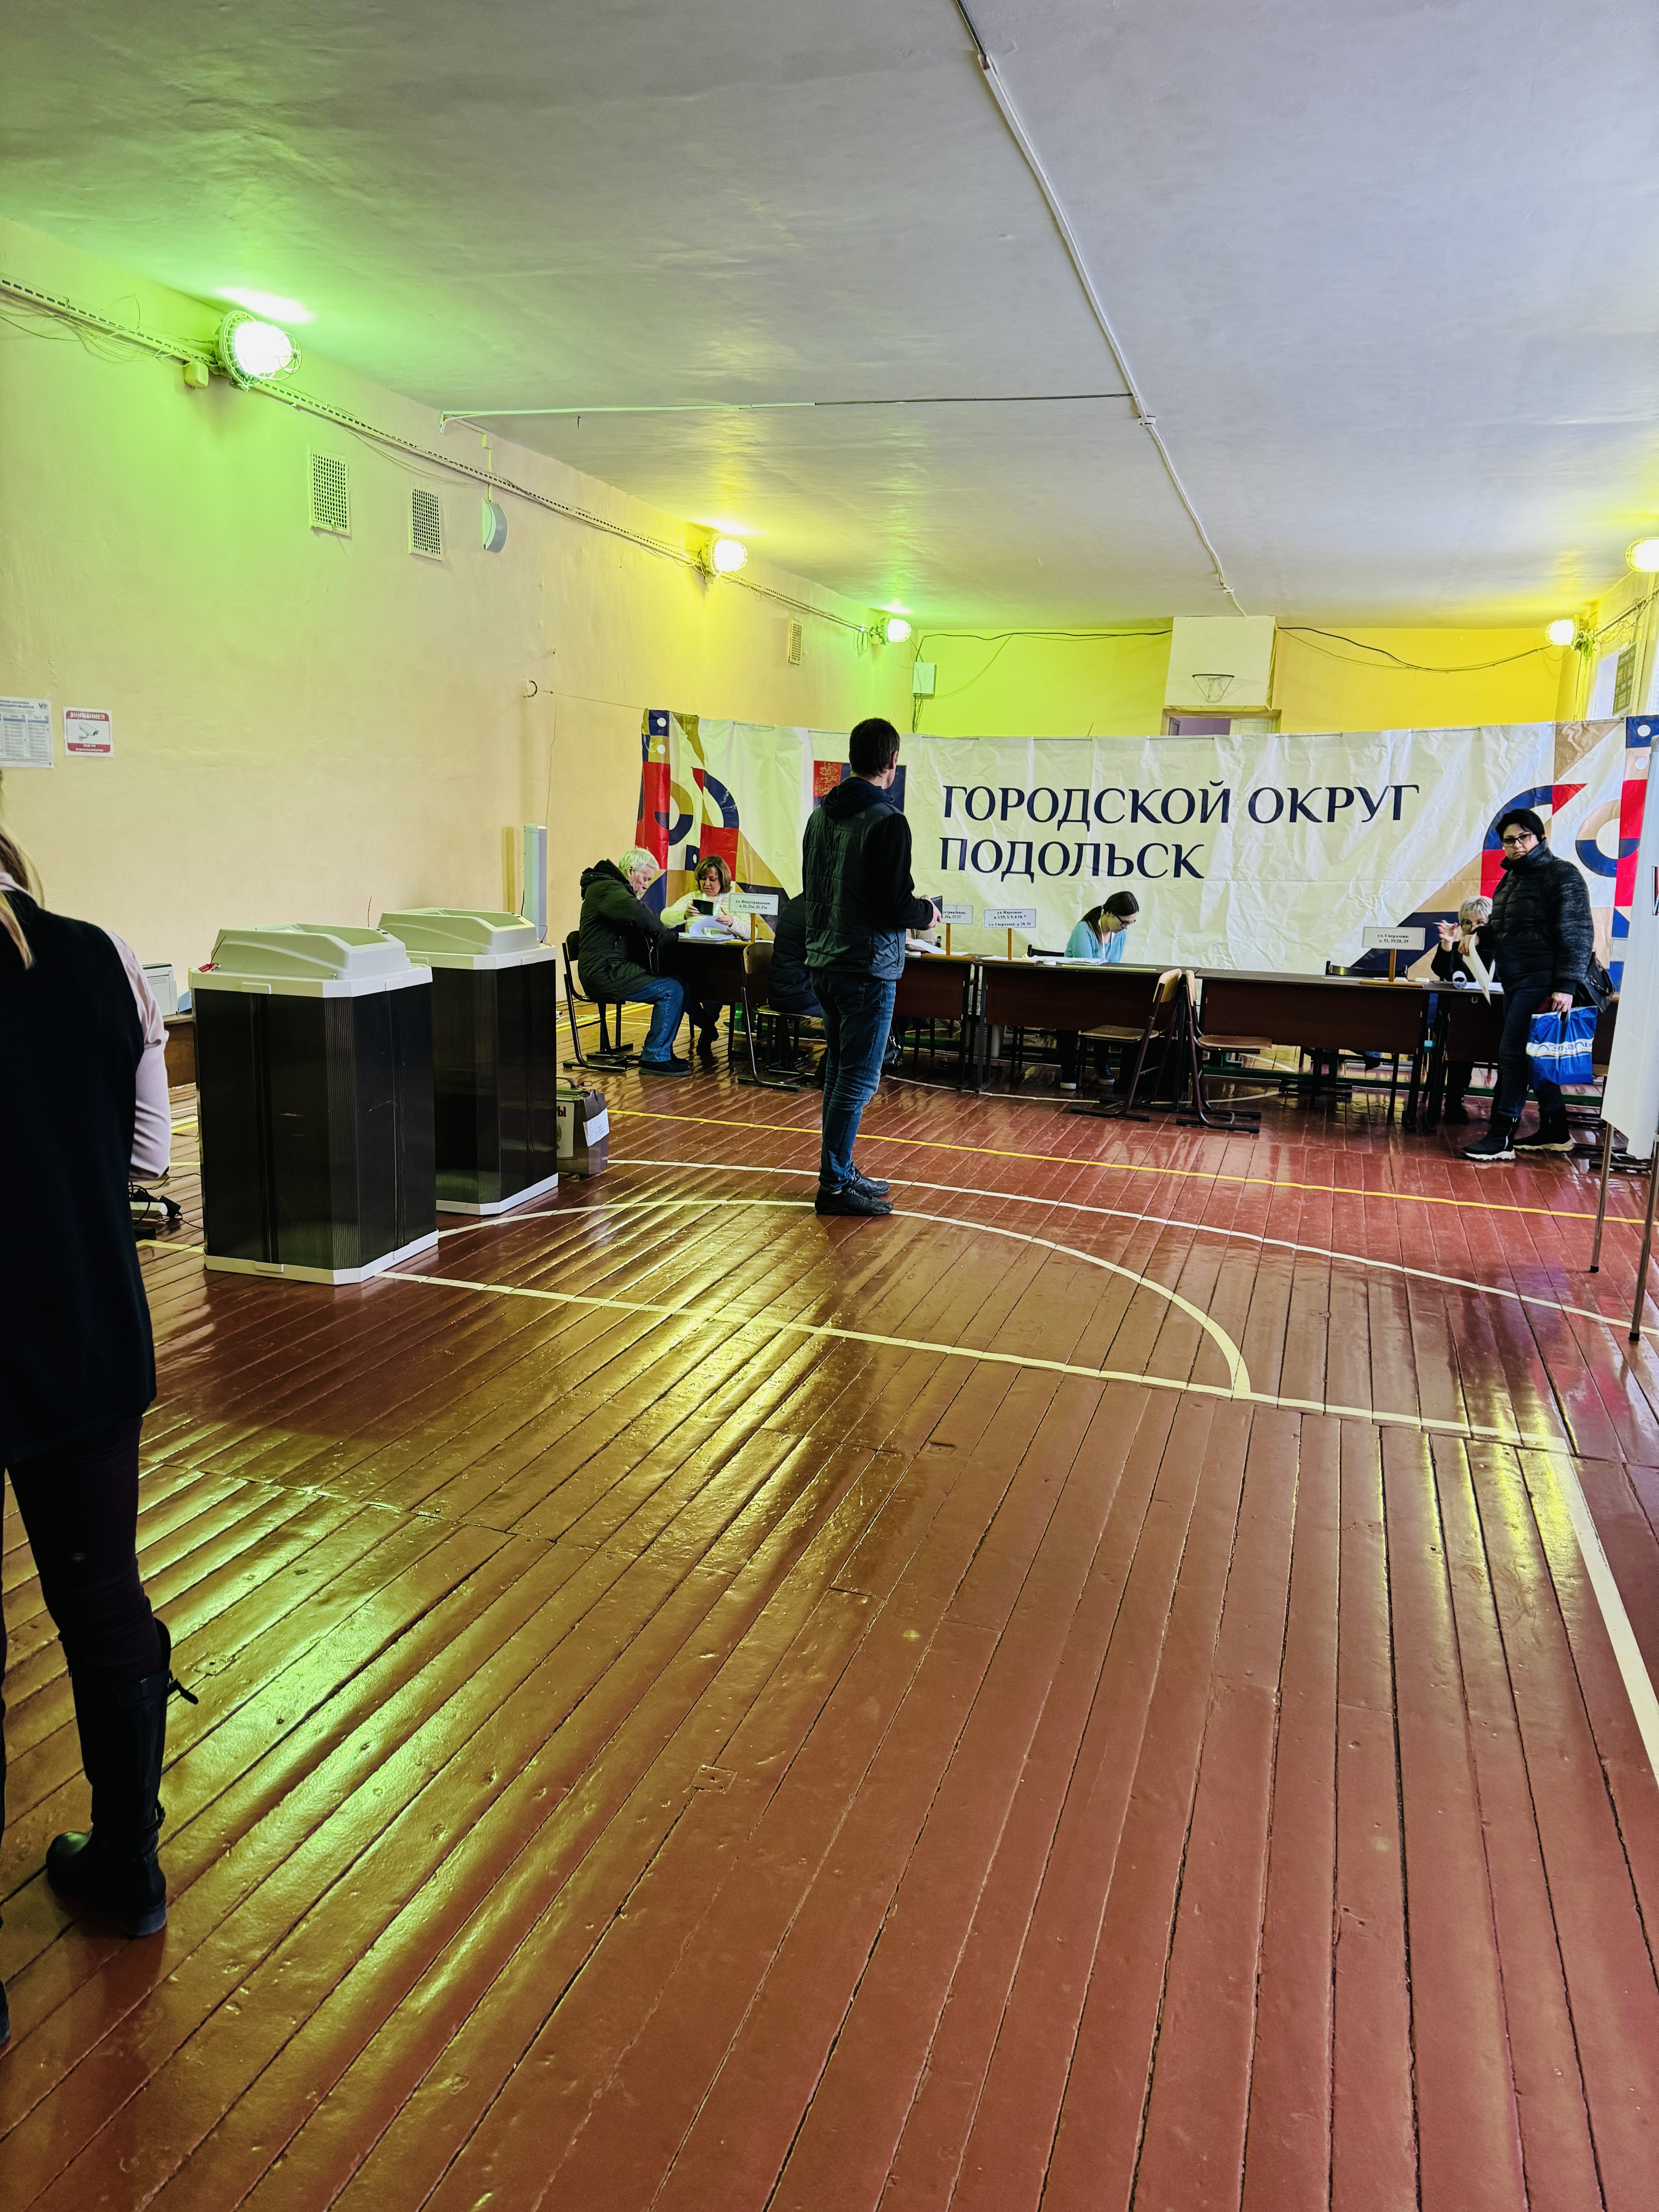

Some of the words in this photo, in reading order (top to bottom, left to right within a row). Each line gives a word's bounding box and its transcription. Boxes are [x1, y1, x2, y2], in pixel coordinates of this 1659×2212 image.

[943, 780, 1231, 832] ГОРОДСКОЙ
[1248, 785, 1420, 824] ОКРУГ
[939, 837, 1205, 883] ПОДОЛЬСК
